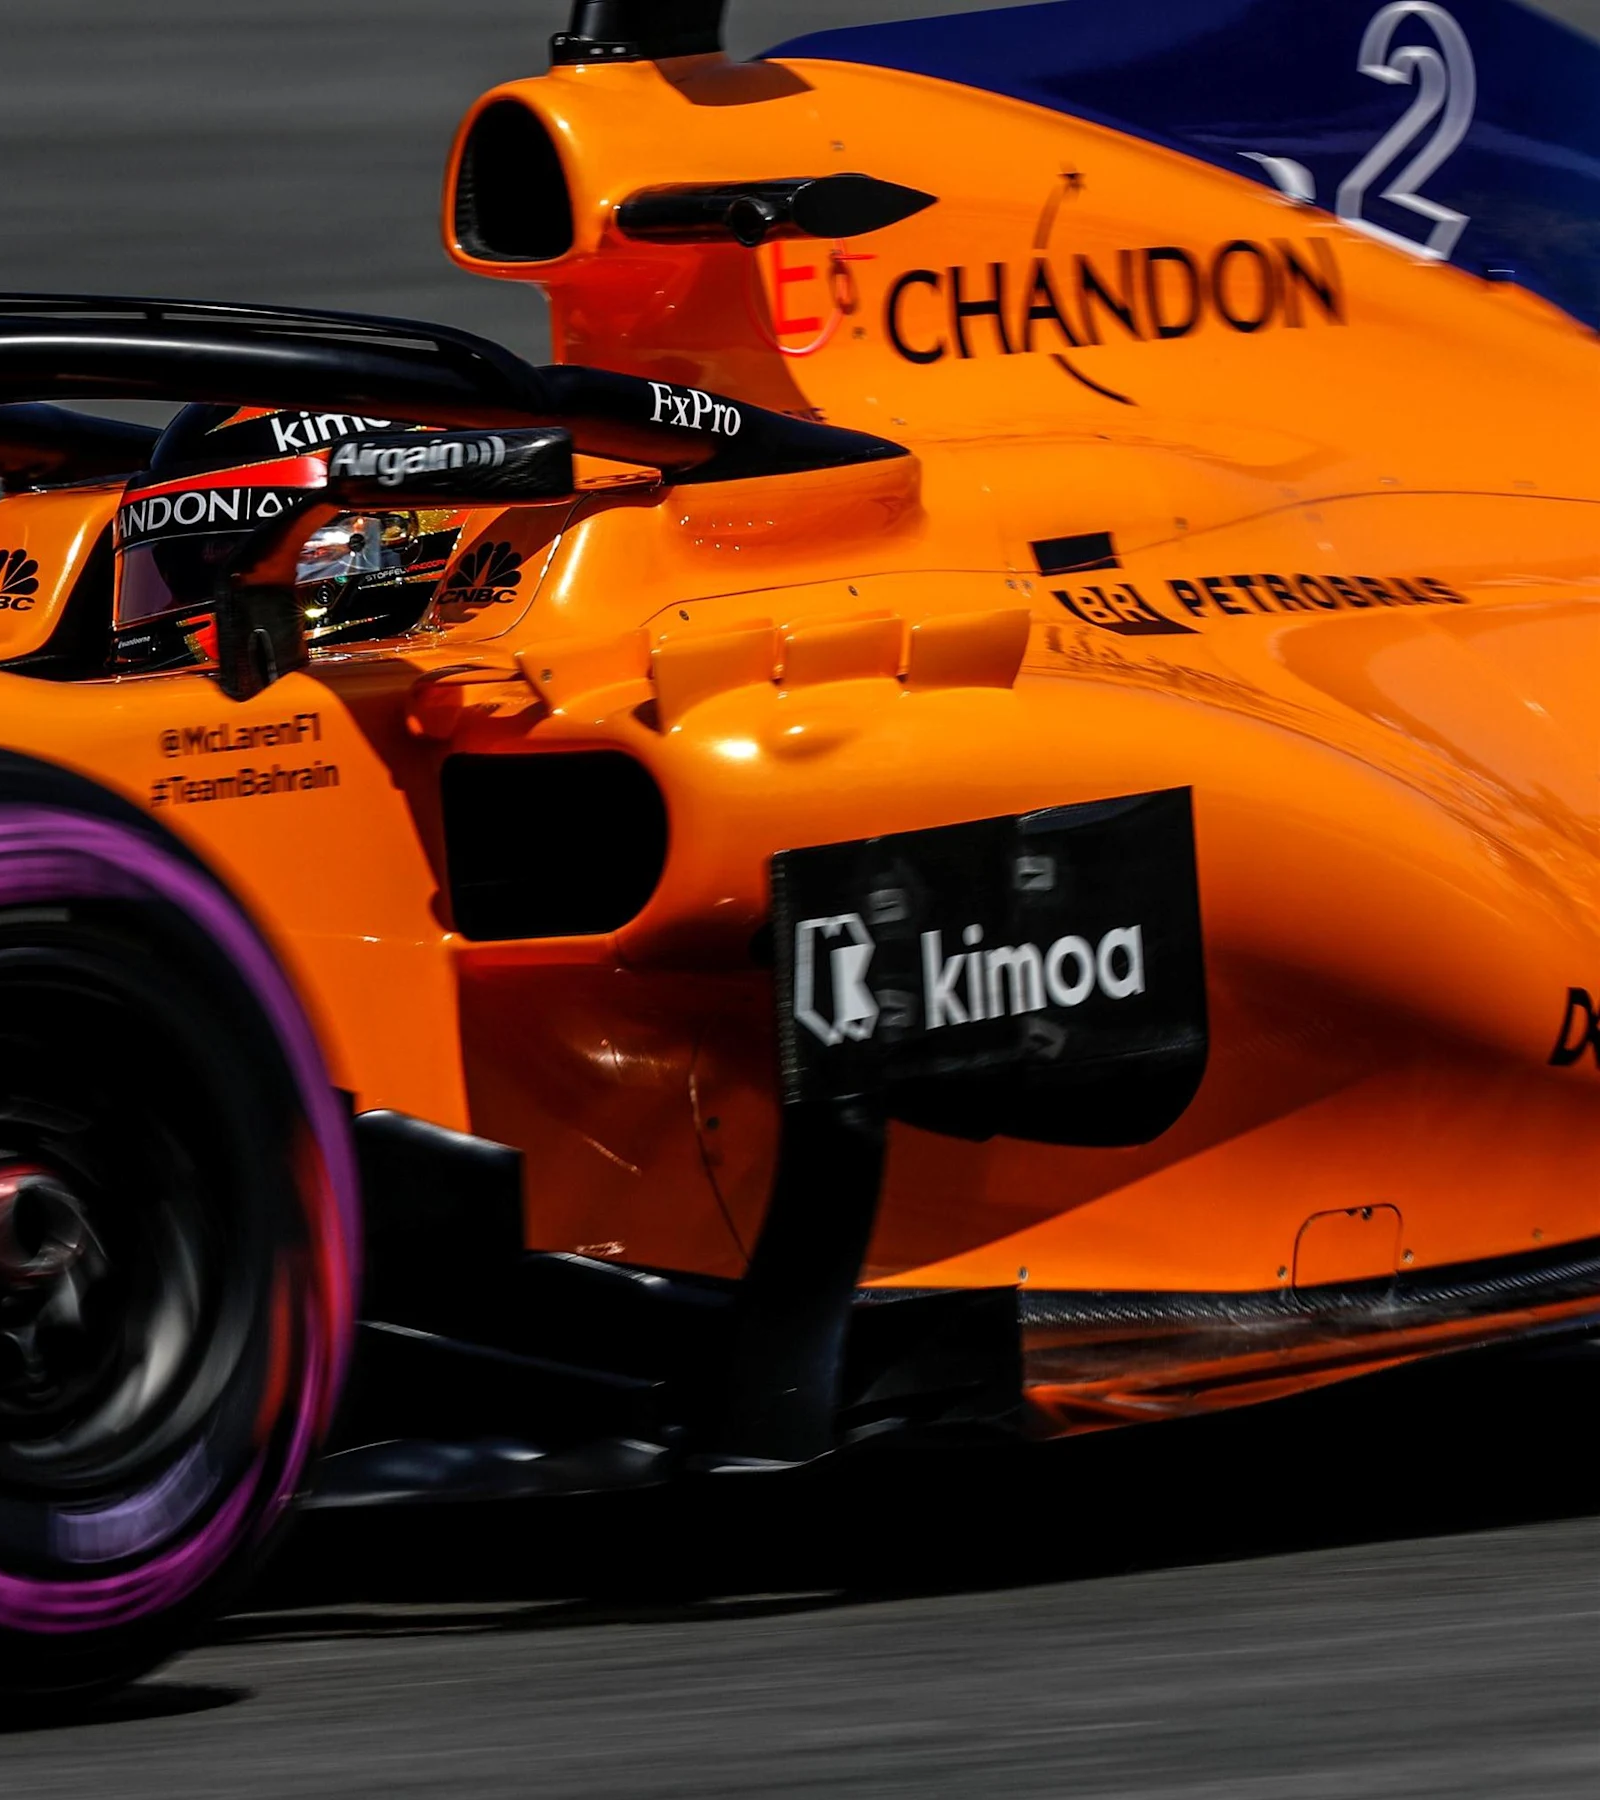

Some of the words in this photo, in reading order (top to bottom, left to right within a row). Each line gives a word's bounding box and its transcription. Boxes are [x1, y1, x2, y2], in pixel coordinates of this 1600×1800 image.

[1336, 0, 1477, 261] 2
[883, 237, 1347, 364] CHANDON
[648, 381, 741, 436] FxPro
[330, 438, 465, 486] Airgain
[438, 588, 518, 605] CNBC
[1164, 573, 1470, 618] PETROBRAS
[158, 712, 323, 759] @McLarenF1
[150, 759, 341, 808] #TeamBahrain
[920, 922, 1147, 1030] kimoa
